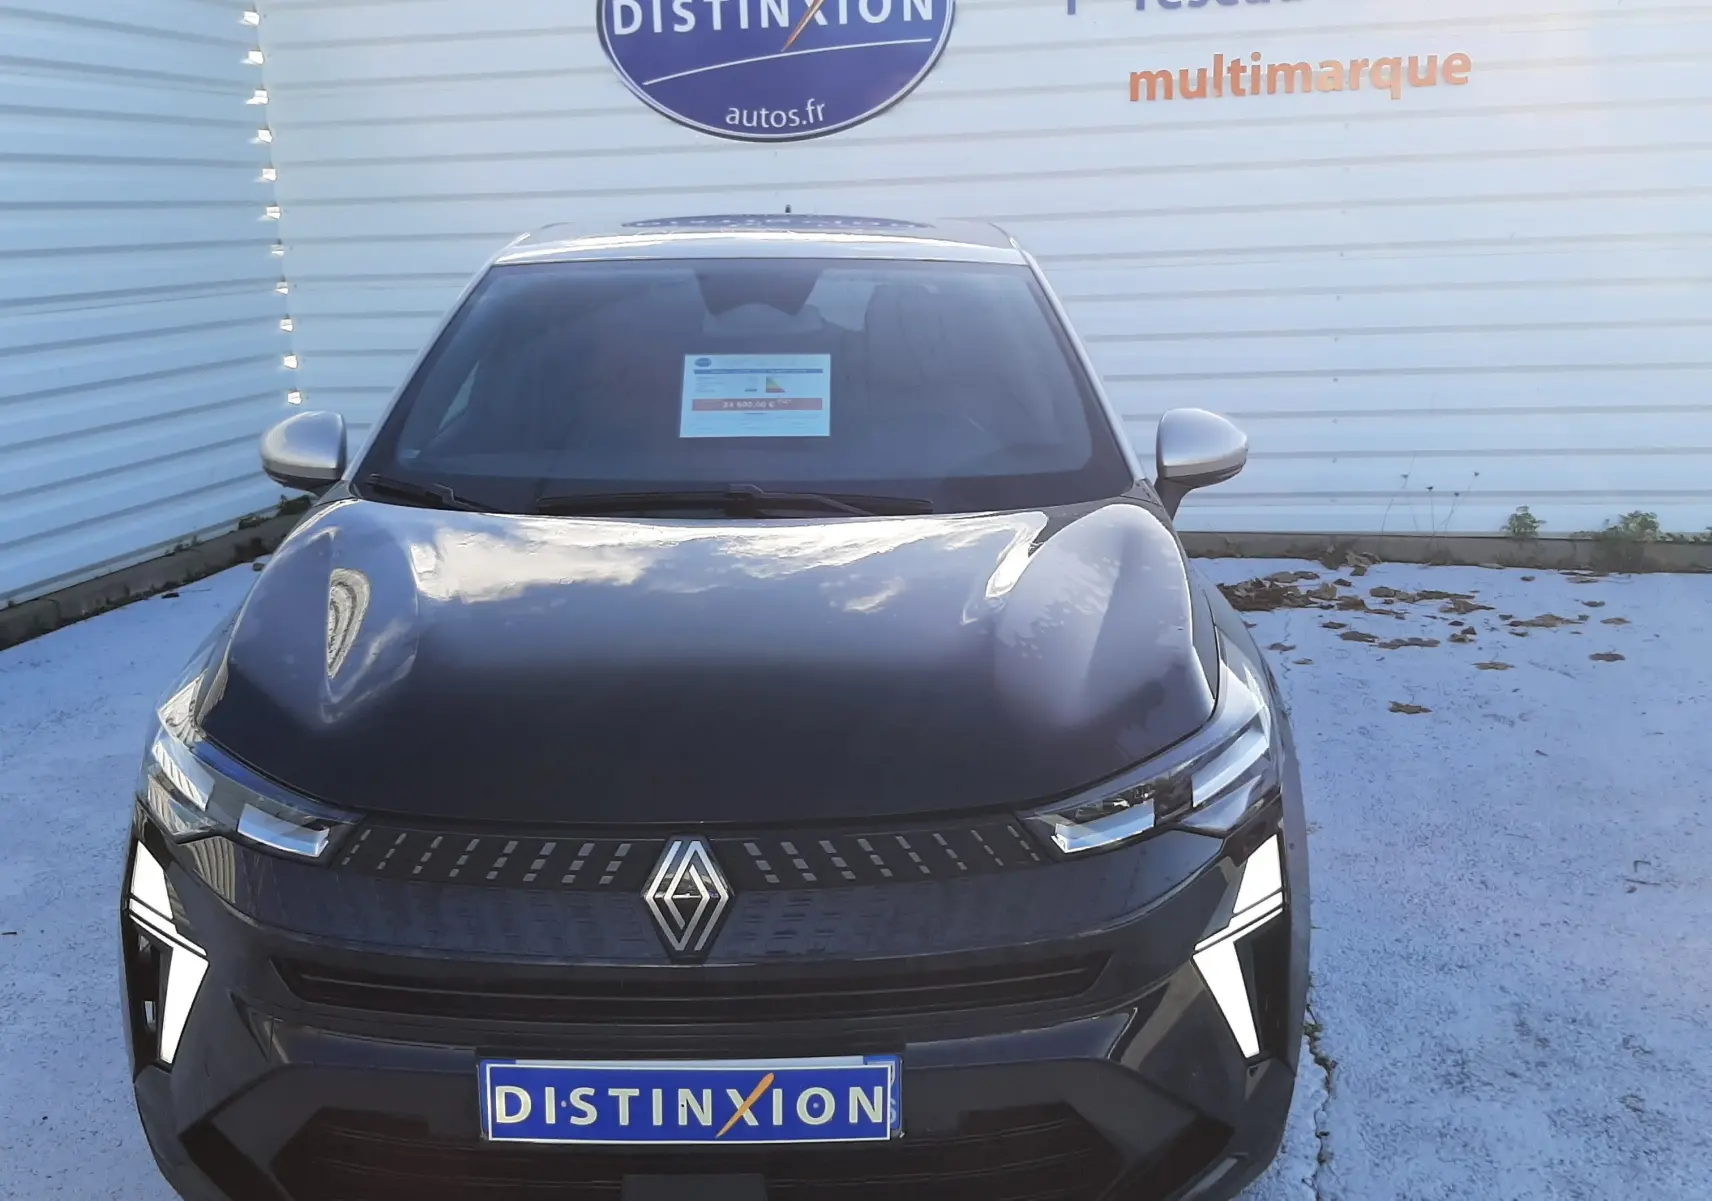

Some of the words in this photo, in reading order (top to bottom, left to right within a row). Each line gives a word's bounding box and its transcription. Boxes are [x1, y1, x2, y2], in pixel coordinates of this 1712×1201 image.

[612, 0, 934, 51] DISTINXION
[1129, 51, 1471, 102] multimarque
[726, 98, 825, 128] autos.fr
[495, 1072, 883, 1138] DISTINXION
